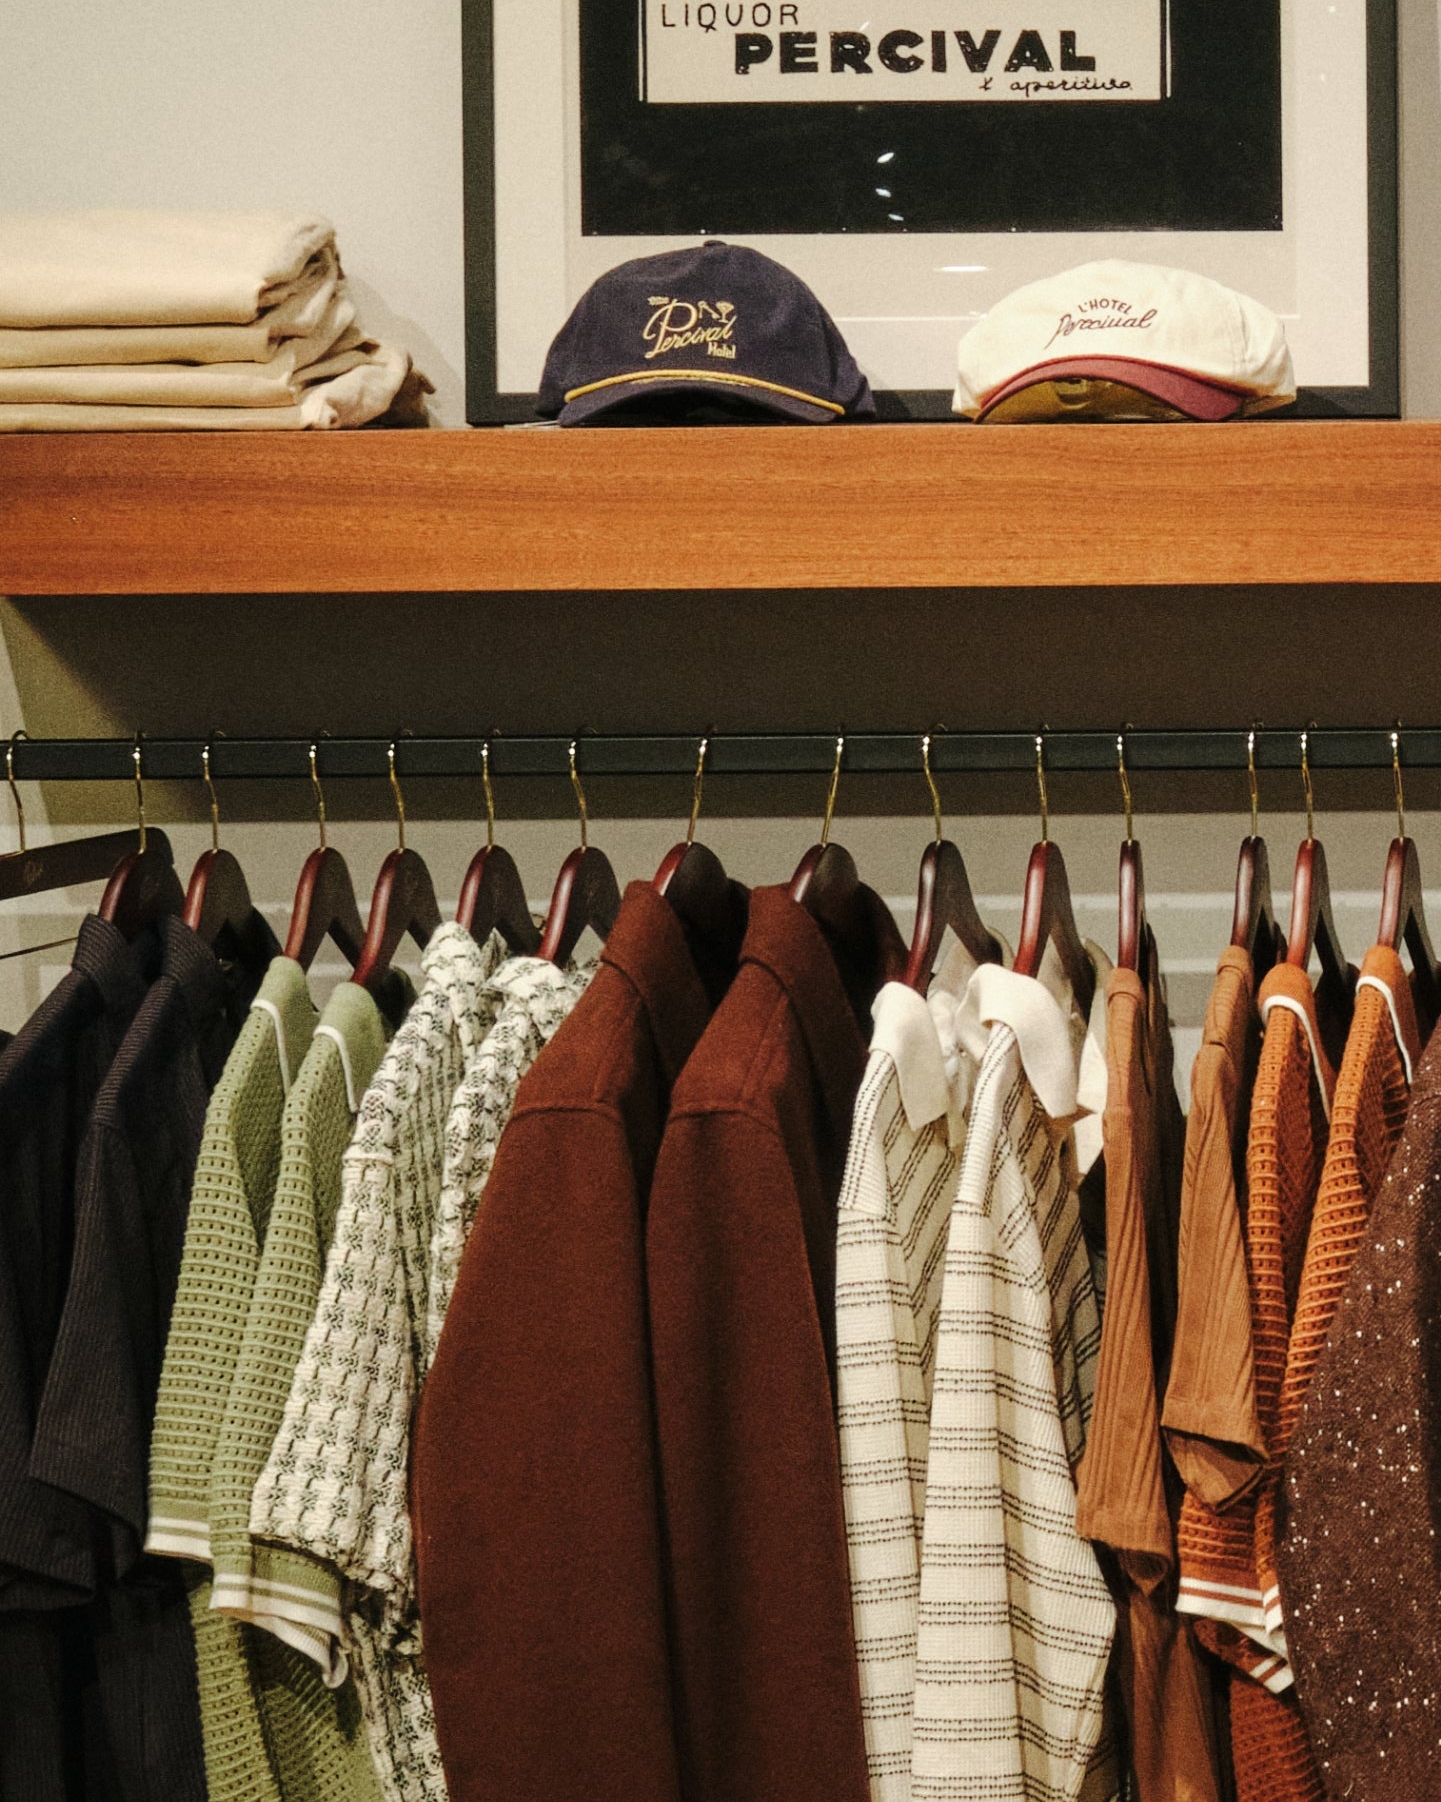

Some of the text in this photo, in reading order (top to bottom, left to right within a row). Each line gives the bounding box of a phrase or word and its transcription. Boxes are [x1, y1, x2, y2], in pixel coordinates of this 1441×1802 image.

[661, 2, 800, 32] LIQUOR
[734, 28, 1097, 75] PERCIVAL
[1078, 298, 1132, 315] L'HOTEL
[643, 299, 737, 359] Percival
[707, 341, 737, 359] Hotel
